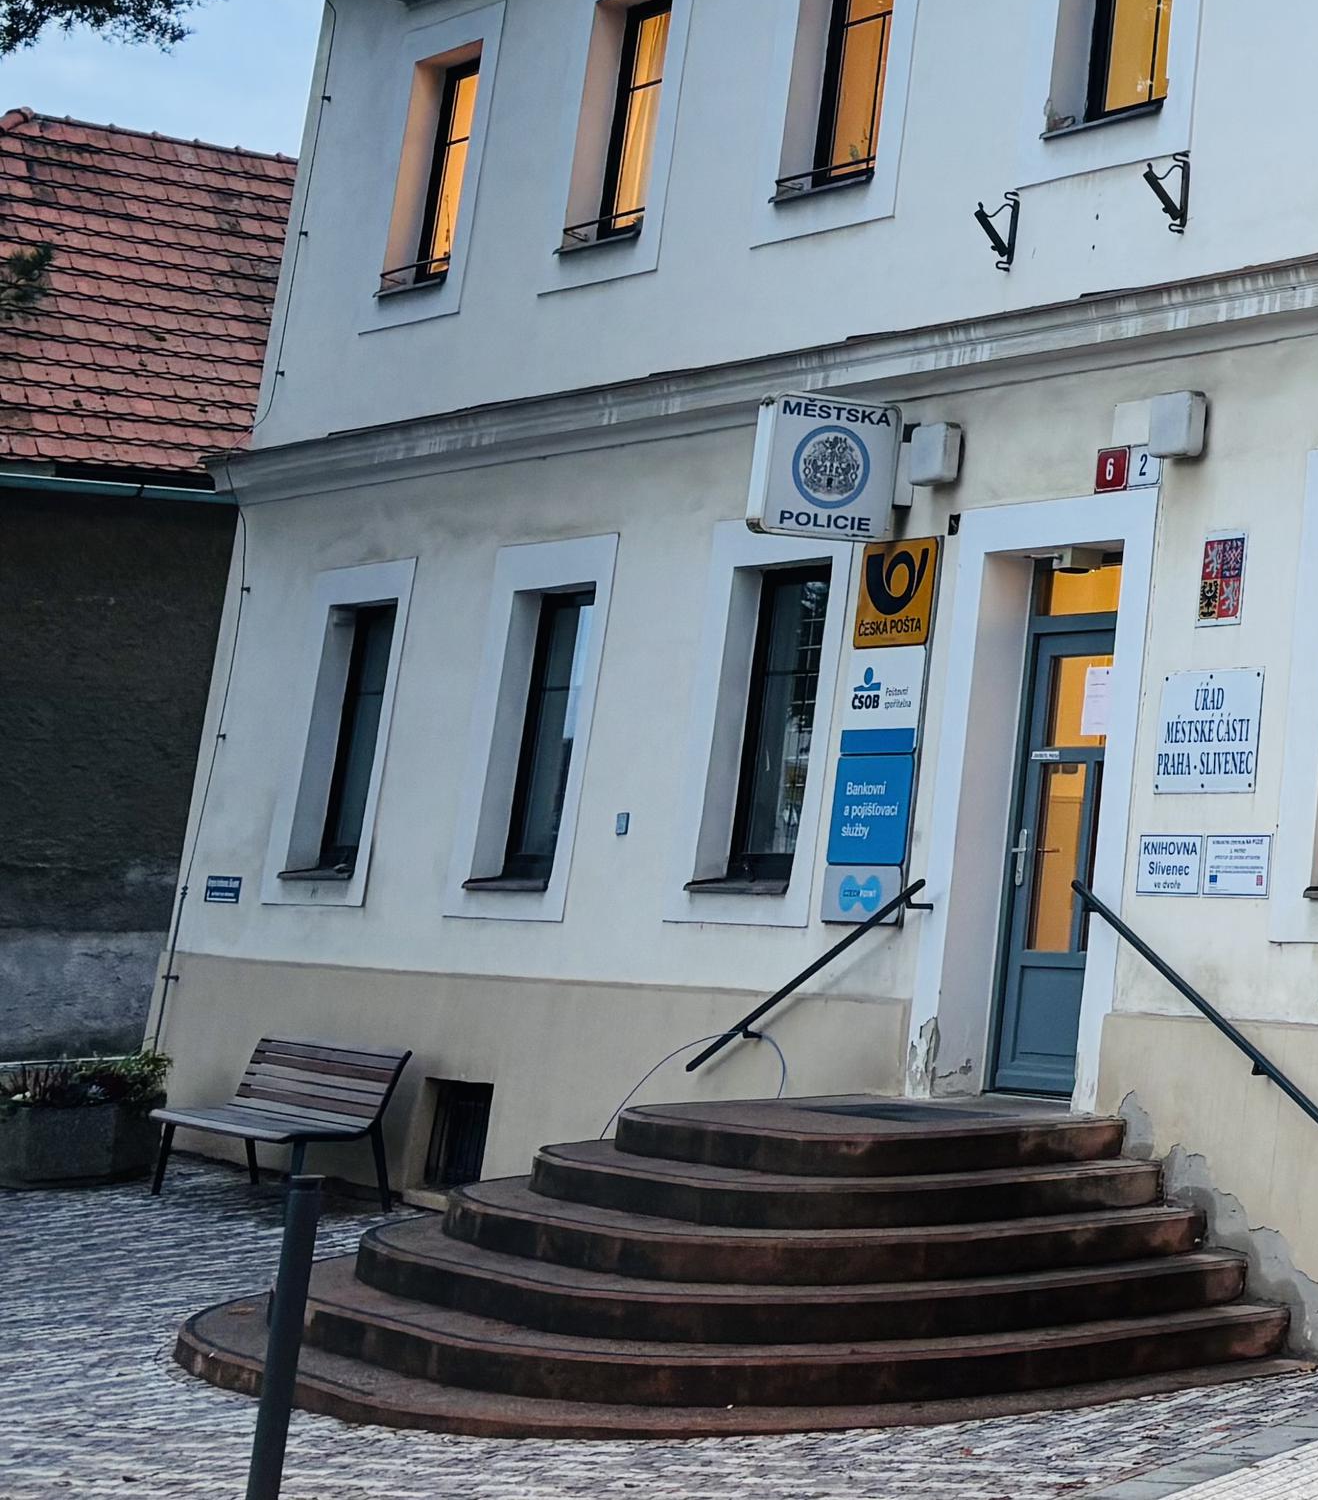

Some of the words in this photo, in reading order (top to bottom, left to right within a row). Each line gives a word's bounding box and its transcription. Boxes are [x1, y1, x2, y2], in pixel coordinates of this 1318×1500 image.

[782, 398, 891, 427] MĚSTSKÁ
[1105, 457, 1115, 481] 6
[1138, 453, 1148, 476] 2
[779, 510, 872, 532] POLICIE
[858, 618, 888, 637] ČESKÁ
[889, 616, 922, 634] POŠTA
[851, 693, 880, 710] ČSOB
[1195, 682, 1225, 711] ÚŘAD
[1164, 713, 1215, 743] MĚSTSKÉ
[1216, 712, 1251, 742] ČÁSTI
[1157, 752, 1191, 776] PRAHA
[1200, 751, 1253, 775] SLIVENEC
[846, 781, 887, 796] Bankovní
[843, 805, 849, 816] a
[851, 802, 899, 819] pojišťovací
[841, 824, 870, 839] služby
[1143, 841, 1198, 856] KNIHOVNA
[1148, 861, 1190, 876] Slivenec
[1162, 880, 1182, 890] dvoře
